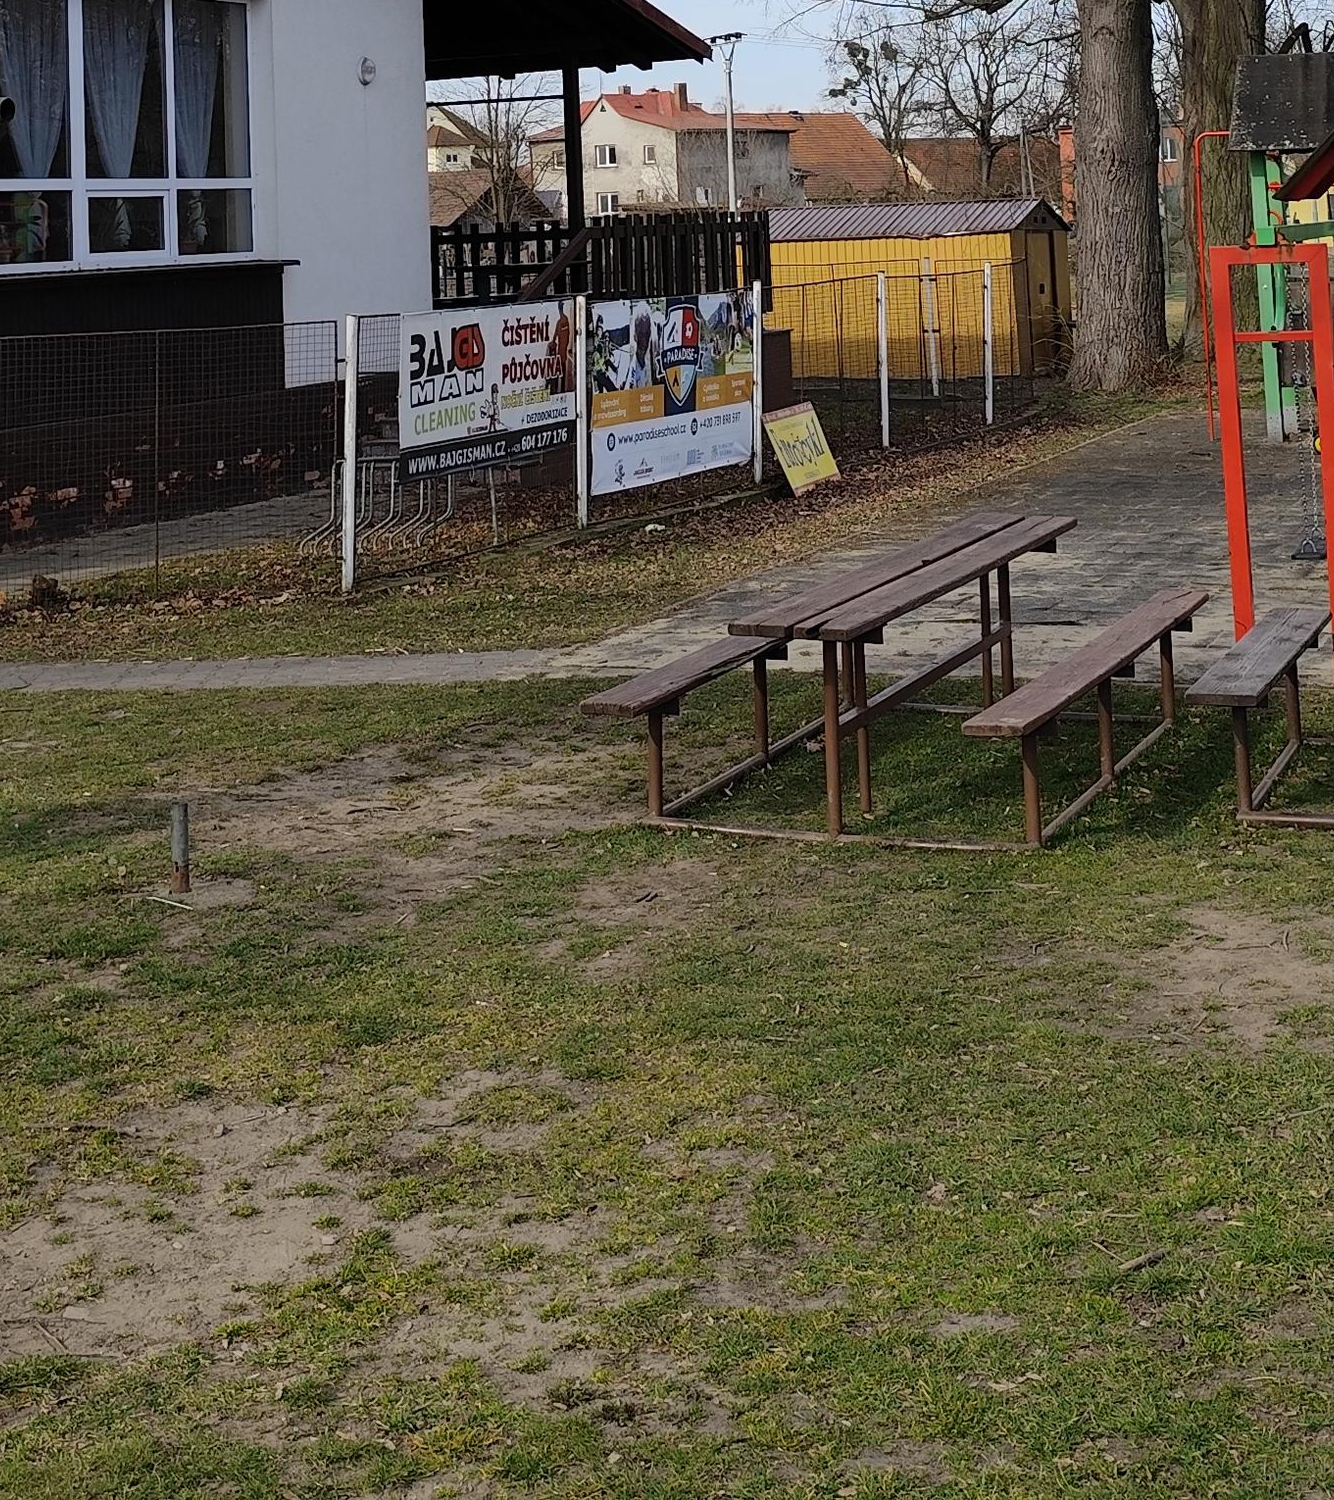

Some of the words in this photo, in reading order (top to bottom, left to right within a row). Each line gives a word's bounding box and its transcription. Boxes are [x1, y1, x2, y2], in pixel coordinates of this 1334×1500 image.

[501, 314, 550, 347] ČIŠTĚNÍ
[501, 353, 564, 385] PŮJČOVNA
[666, 347, 695, 364] PARADISE
[409, 368, 484, 408] MAN
[413, 402, 476, 436] CLEANING
[617, 422, 687, 444] www.paradiseschool.cz
[408, 440, 506, 475] WWW.BAJGISMAN.CZ
[522, 435, 536, 451] 604
[537, 431, 552, 448] 177
[553, 427, 568, 444] 176
